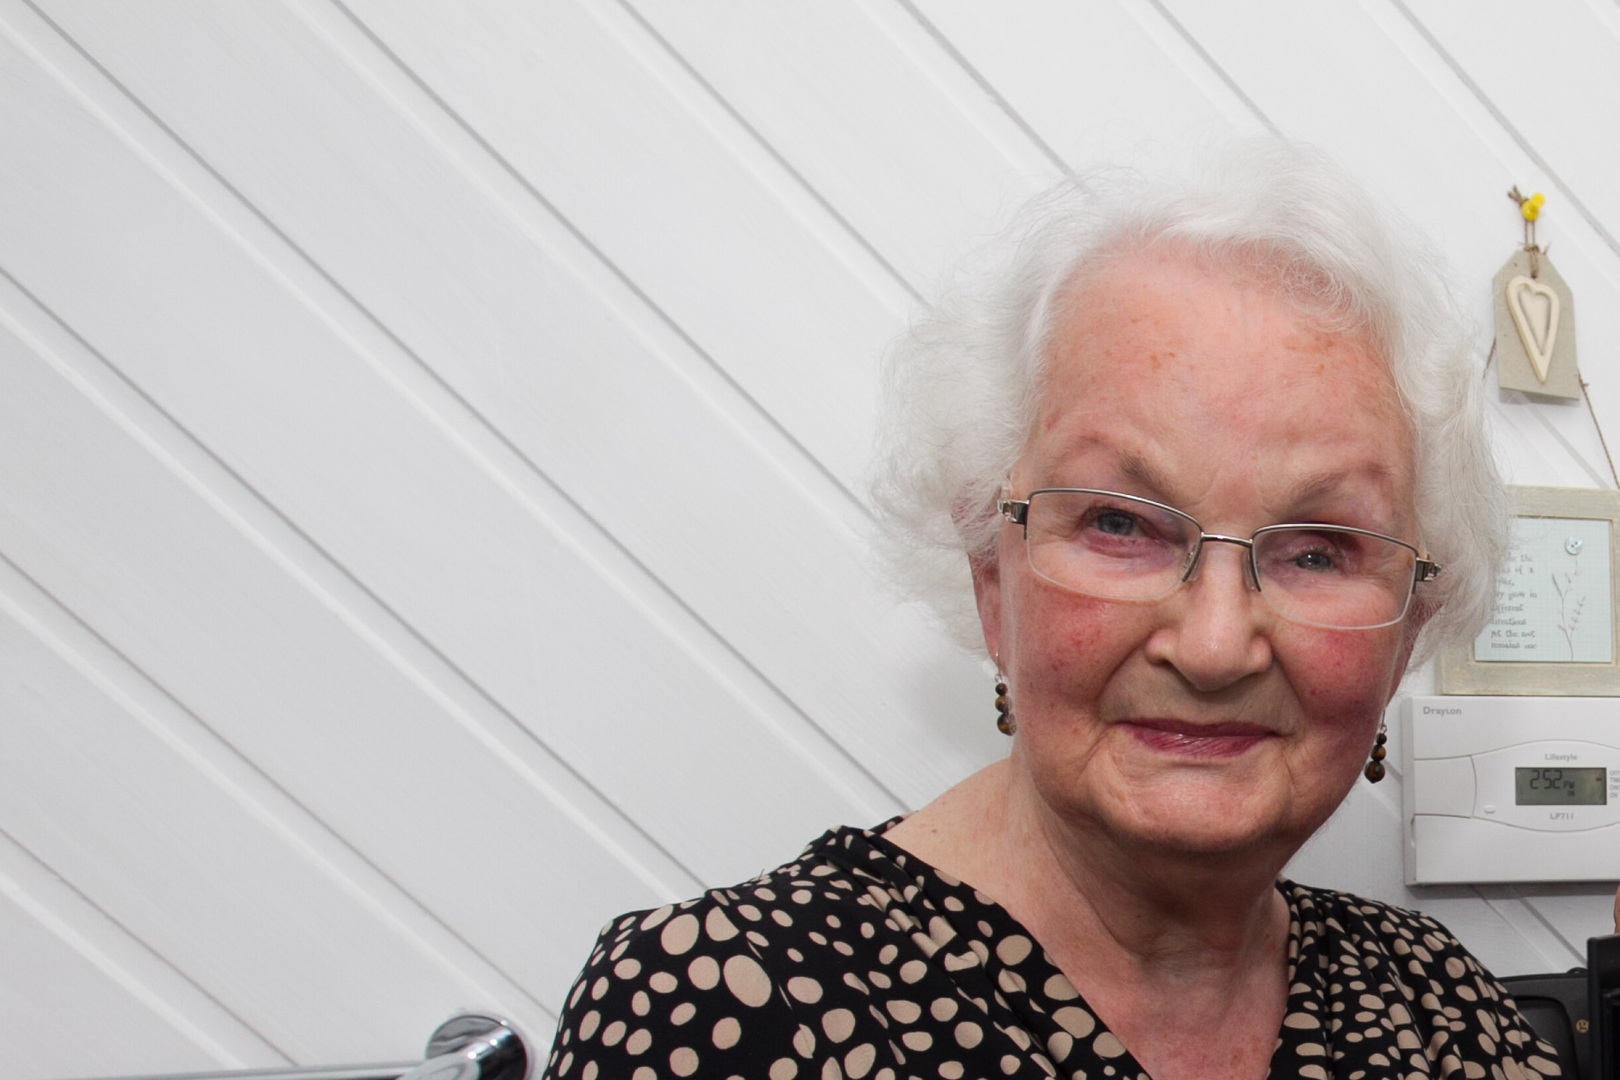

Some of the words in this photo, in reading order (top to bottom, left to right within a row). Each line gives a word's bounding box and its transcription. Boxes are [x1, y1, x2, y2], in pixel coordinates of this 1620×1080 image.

[1506, 629, 1518, 638] the
[1544, 752, 1578, 763] Lifestyle
[1609, 769, 1620, 777] OFF
[1549, 812, 1574, 821] LP711
